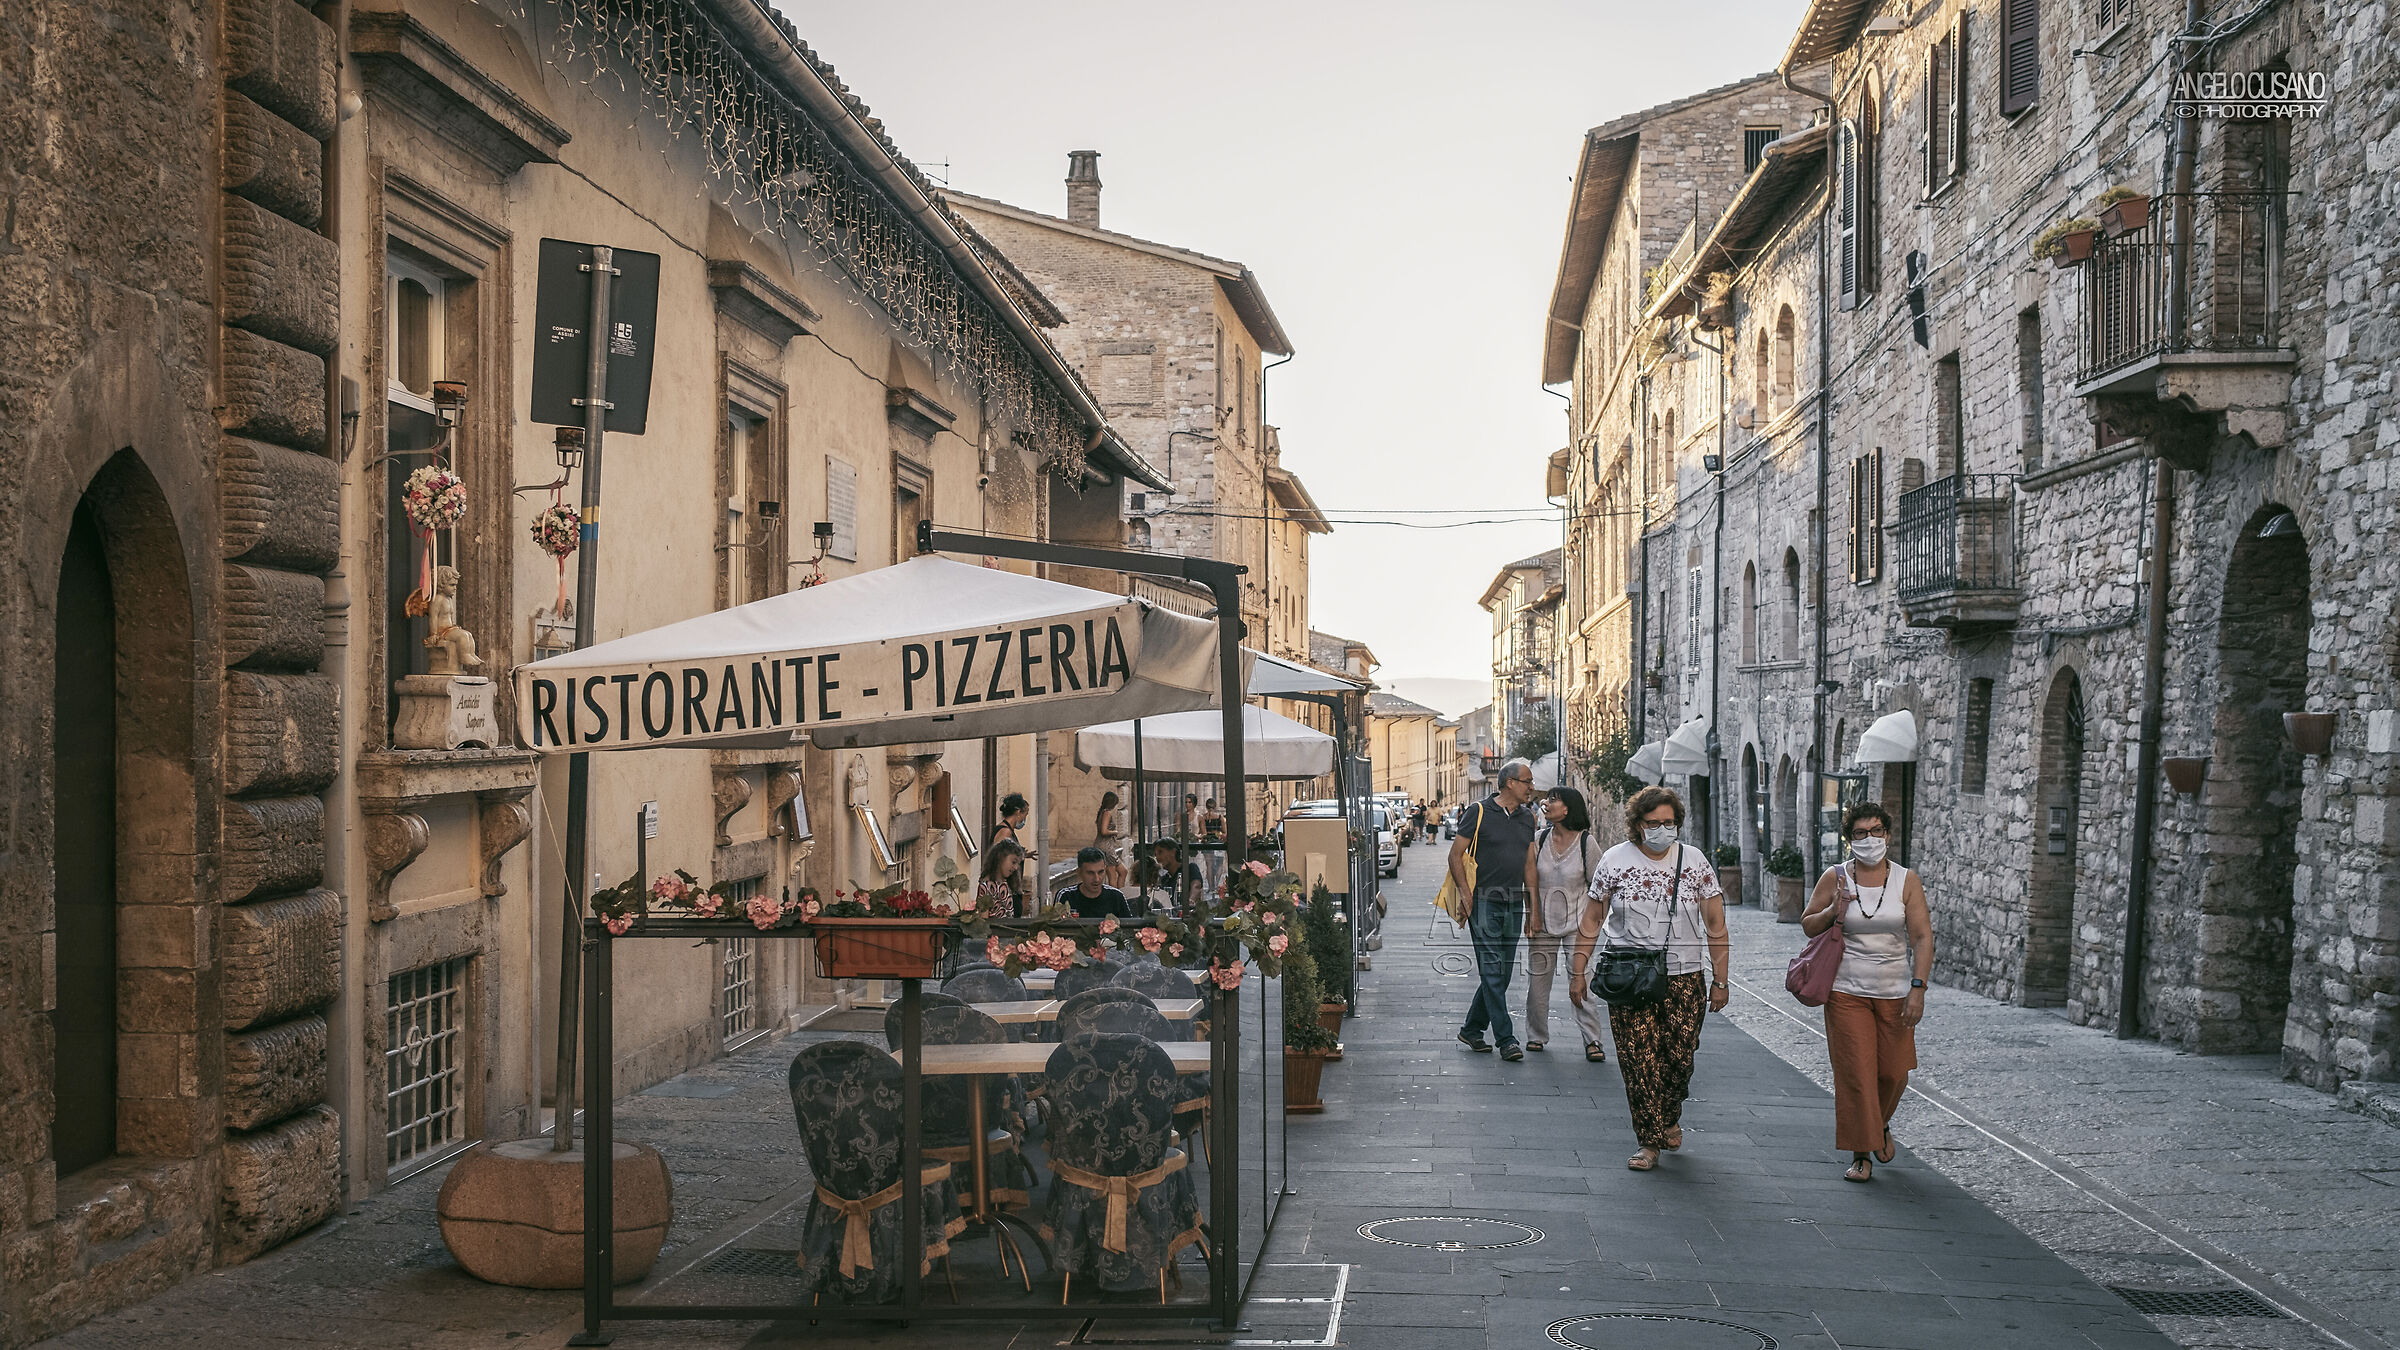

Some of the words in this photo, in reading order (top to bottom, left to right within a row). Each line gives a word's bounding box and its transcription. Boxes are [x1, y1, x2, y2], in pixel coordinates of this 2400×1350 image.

[532, 653, 842, 746] RISTORANTE
[902, 617, 1131, 711] PIZZERIA
[456, 695, 481, 710] Antichi
[465, 713, 486, 733] Sapori
